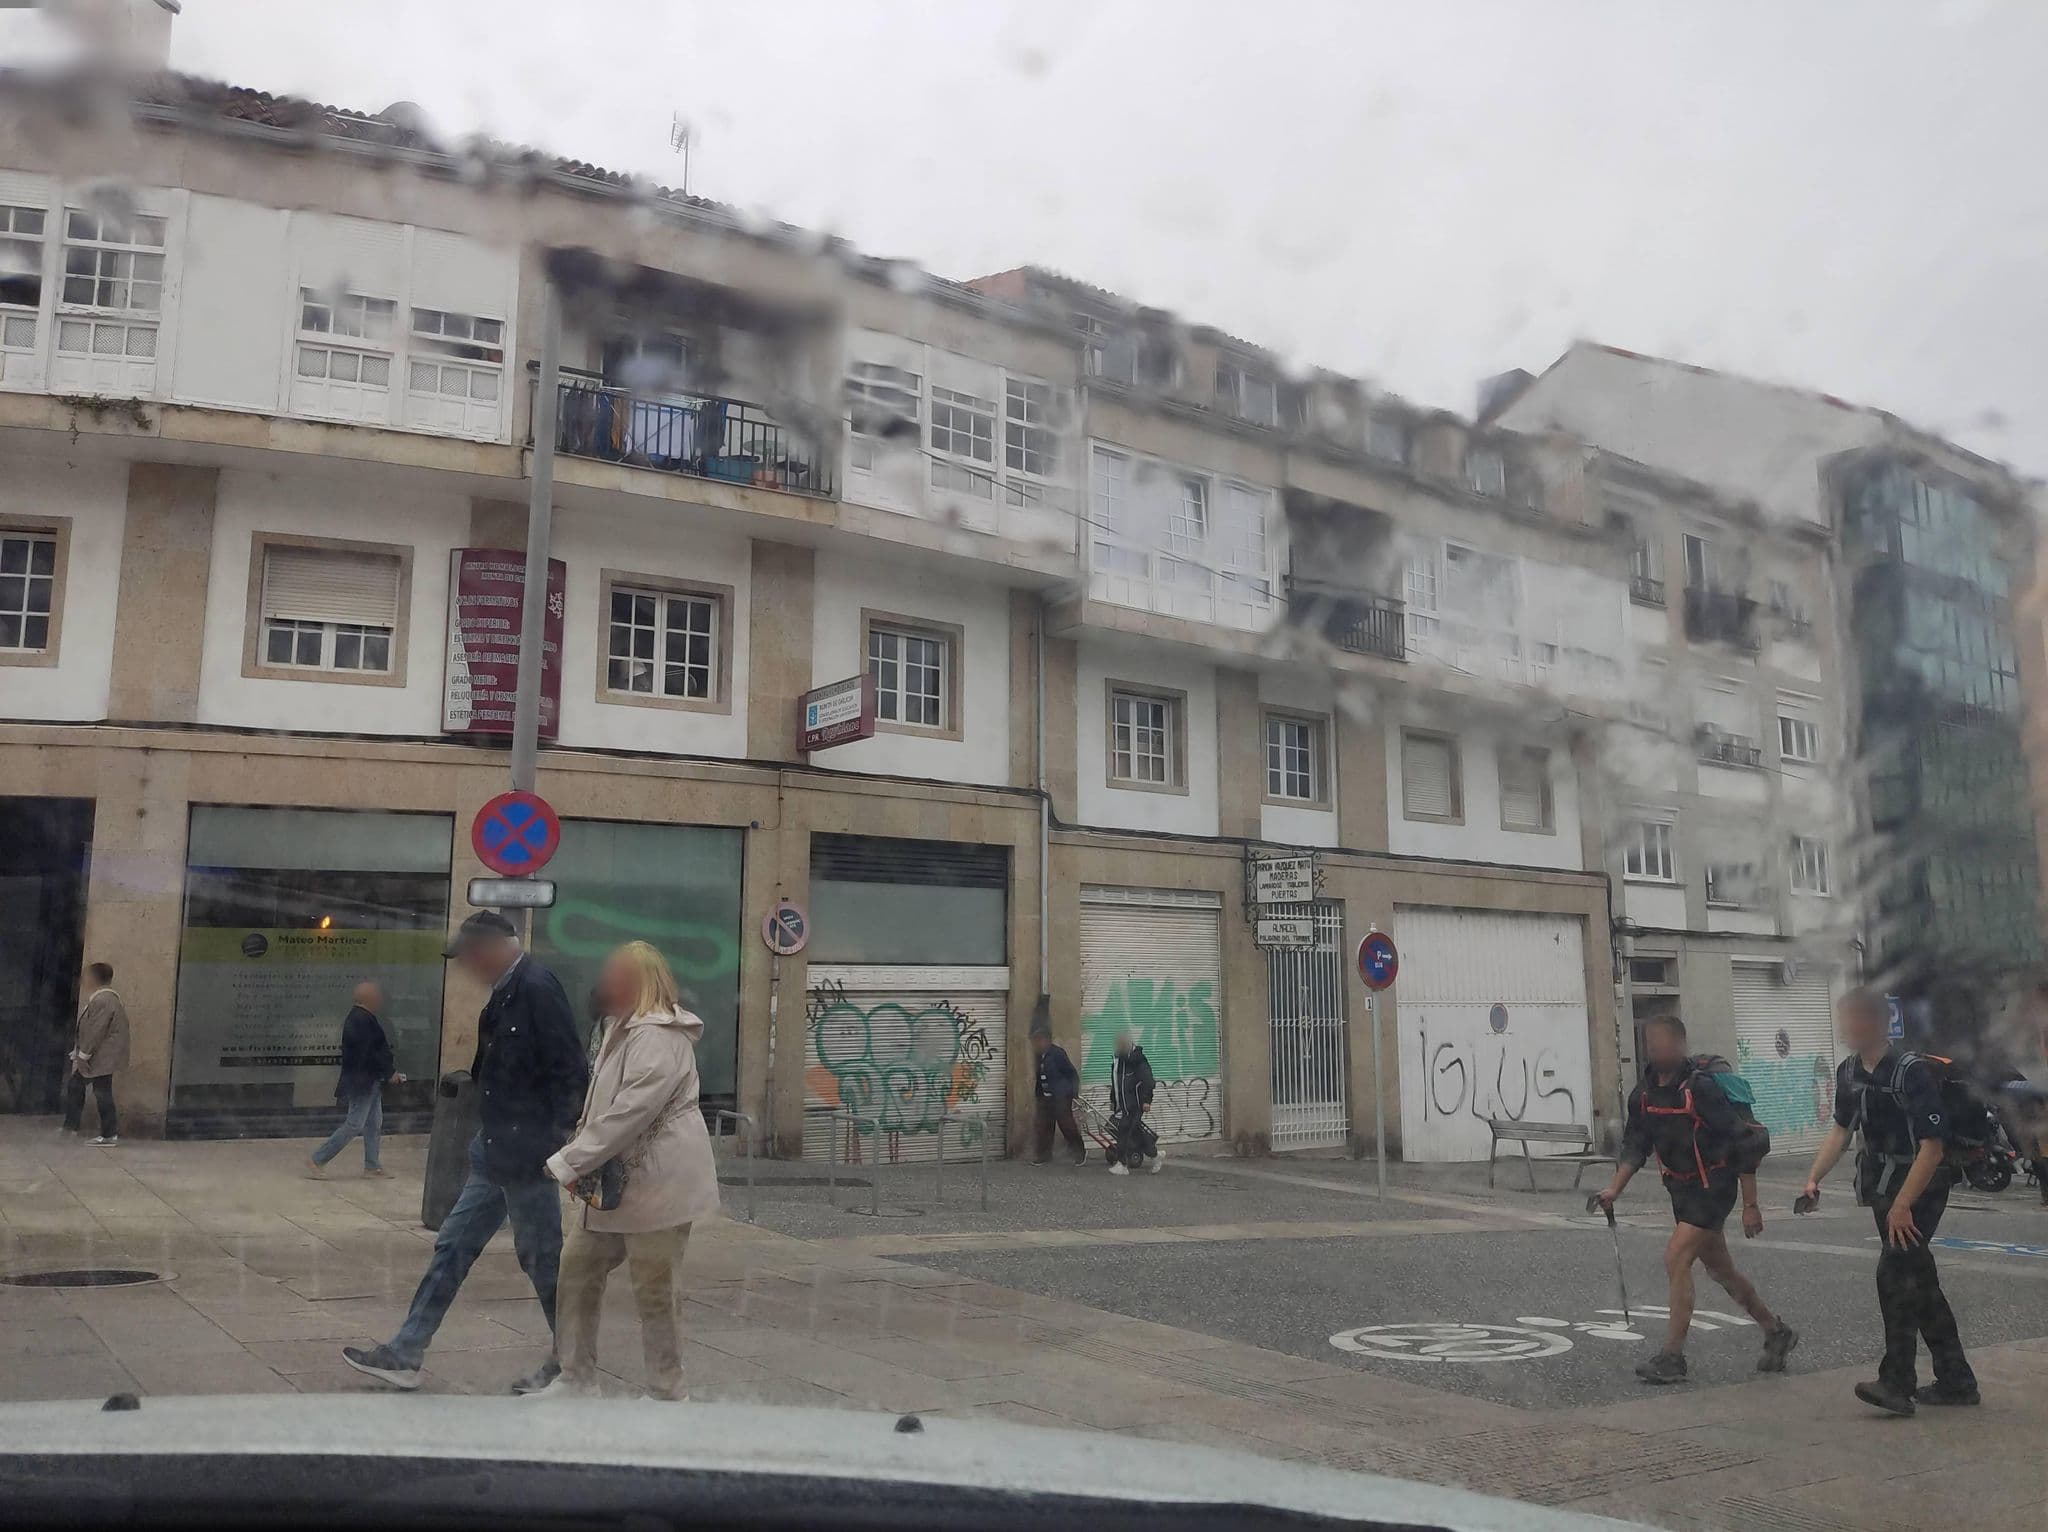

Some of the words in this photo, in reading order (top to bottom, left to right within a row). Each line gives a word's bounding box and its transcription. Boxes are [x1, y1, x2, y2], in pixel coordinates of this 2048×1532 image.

[1270, 871, 1298, 880] MADERAS
[1271, 890, 1298, 899] PUERTAS
[278, 935, 314, 945] Mateo
